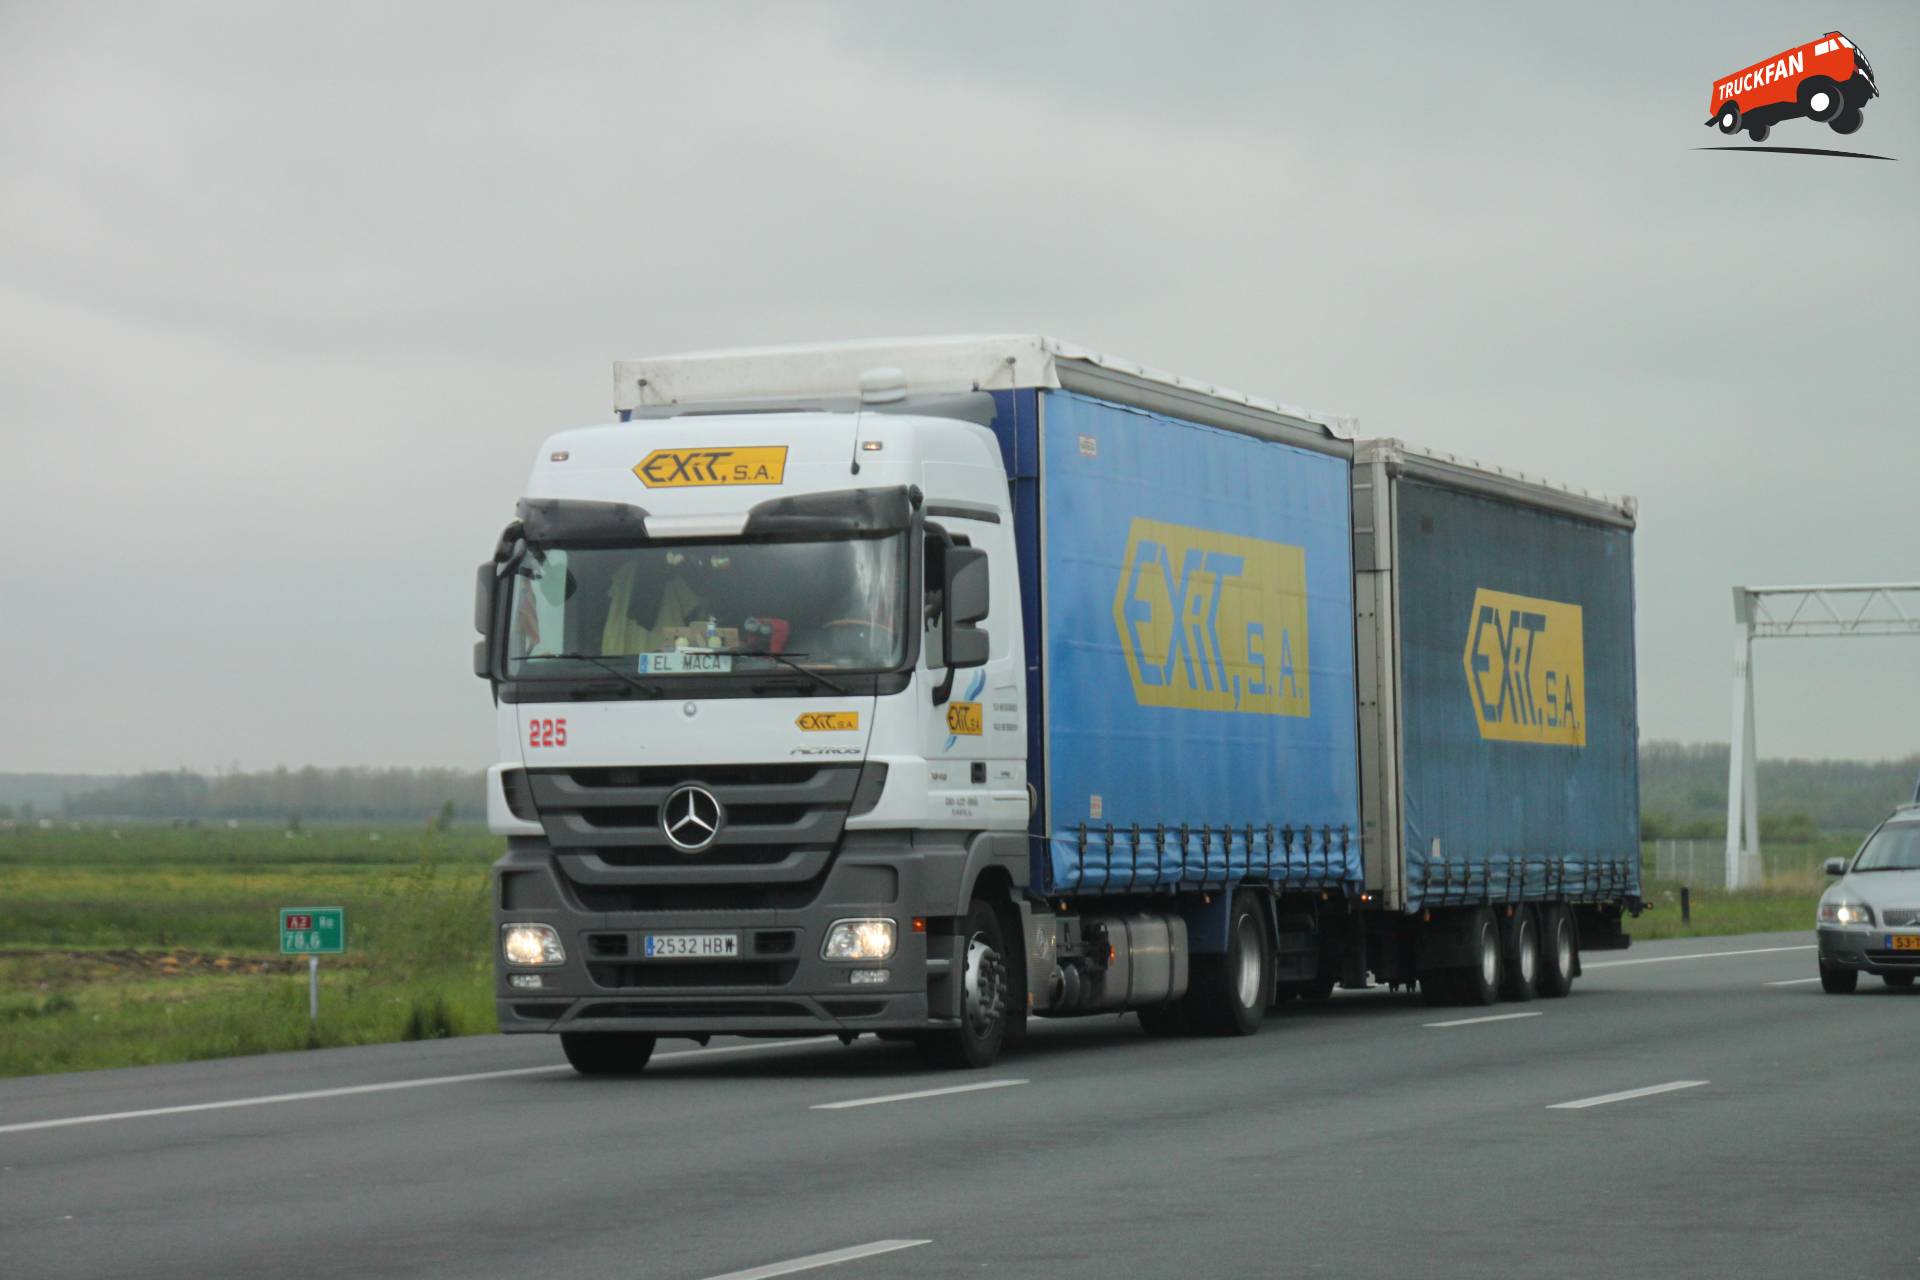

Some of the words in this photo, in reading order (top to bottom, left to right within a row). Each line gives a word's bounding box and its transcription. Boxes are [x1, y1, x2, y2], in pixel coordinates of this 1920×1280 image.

[654, 656, 672, 670] EL
[682, 655, 721, 670] MACA
[529, 719, 567, 747] 225
[656, 938, 697, 954] 2532
